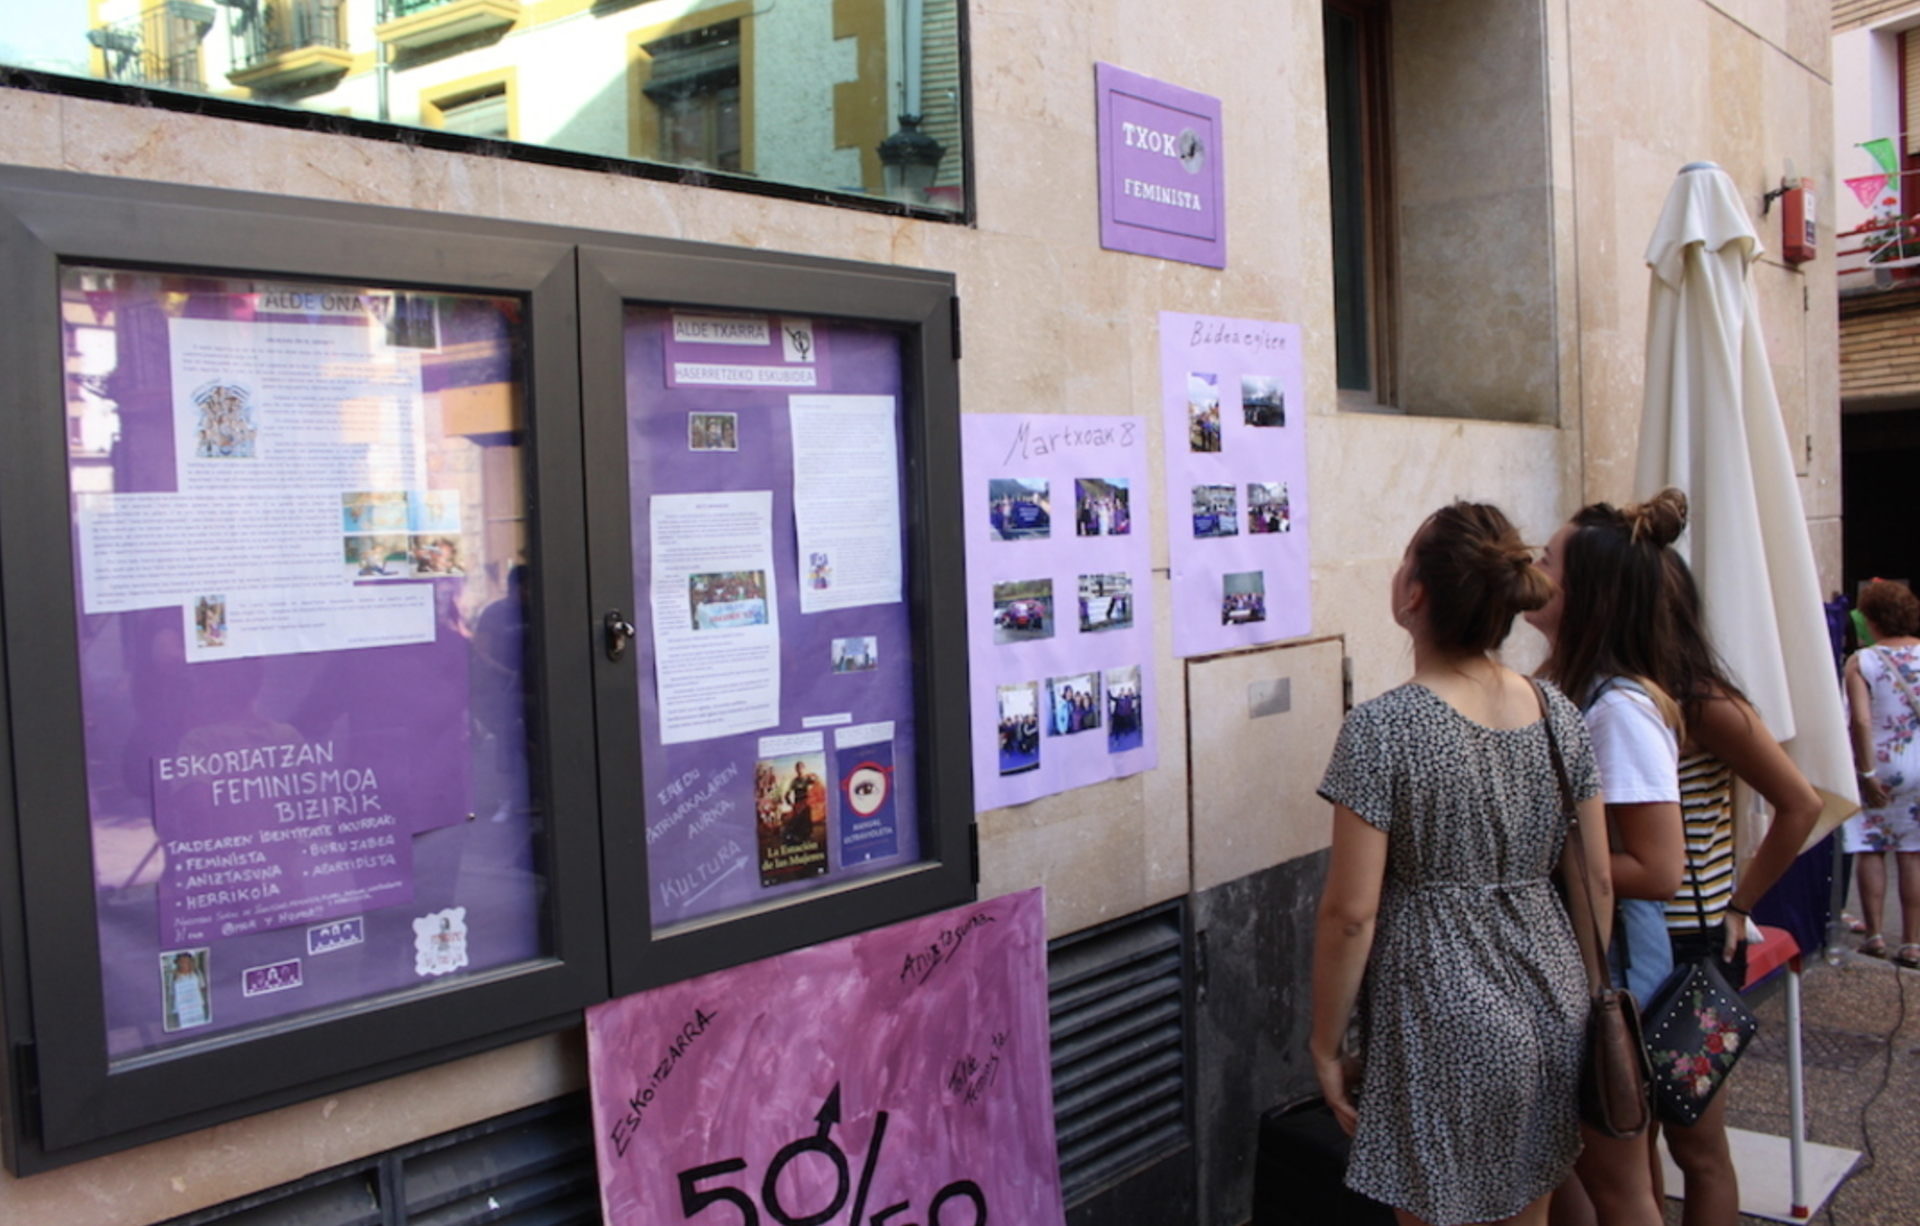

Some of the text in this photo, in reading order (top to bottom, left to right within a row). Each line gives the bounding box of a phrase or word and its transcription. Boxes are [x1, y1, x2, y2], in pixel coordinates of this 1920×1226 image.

[1122, 121, 1184, 160] TXOK
[1124, 178, 1202, 211] FEMINISTA
[265, 291, 364, 312] ALDE ONA
[676, 321, 766, 339] ALDE TXARRA
[1190, 320, 1240, 347] Bidea
[675, 365, 816, 383] HASERRETZEKO ESKUBIDEA
[1120, 421, 1136, 448] 8
[159, 741, 334, 780] ESKORIATZAN
[212, 768, 378, 806] FEMINISMOA
[657, 768, 701, 806] EREDU
[274, 794, 382, 823] BIZIRIK
[168, 835, 253, 855] TALDEAREN
[259, 823, 334, 843] IDENTITATE
[767, 846, 780, 858] La
[186, 852, 267, 871] FEMINISTA
[660, 840, 742, 908] KULTURA
[185, 864, 283, 890] ANIZTASUNA
[187, 883, 280, 911] HERRIKOIA
